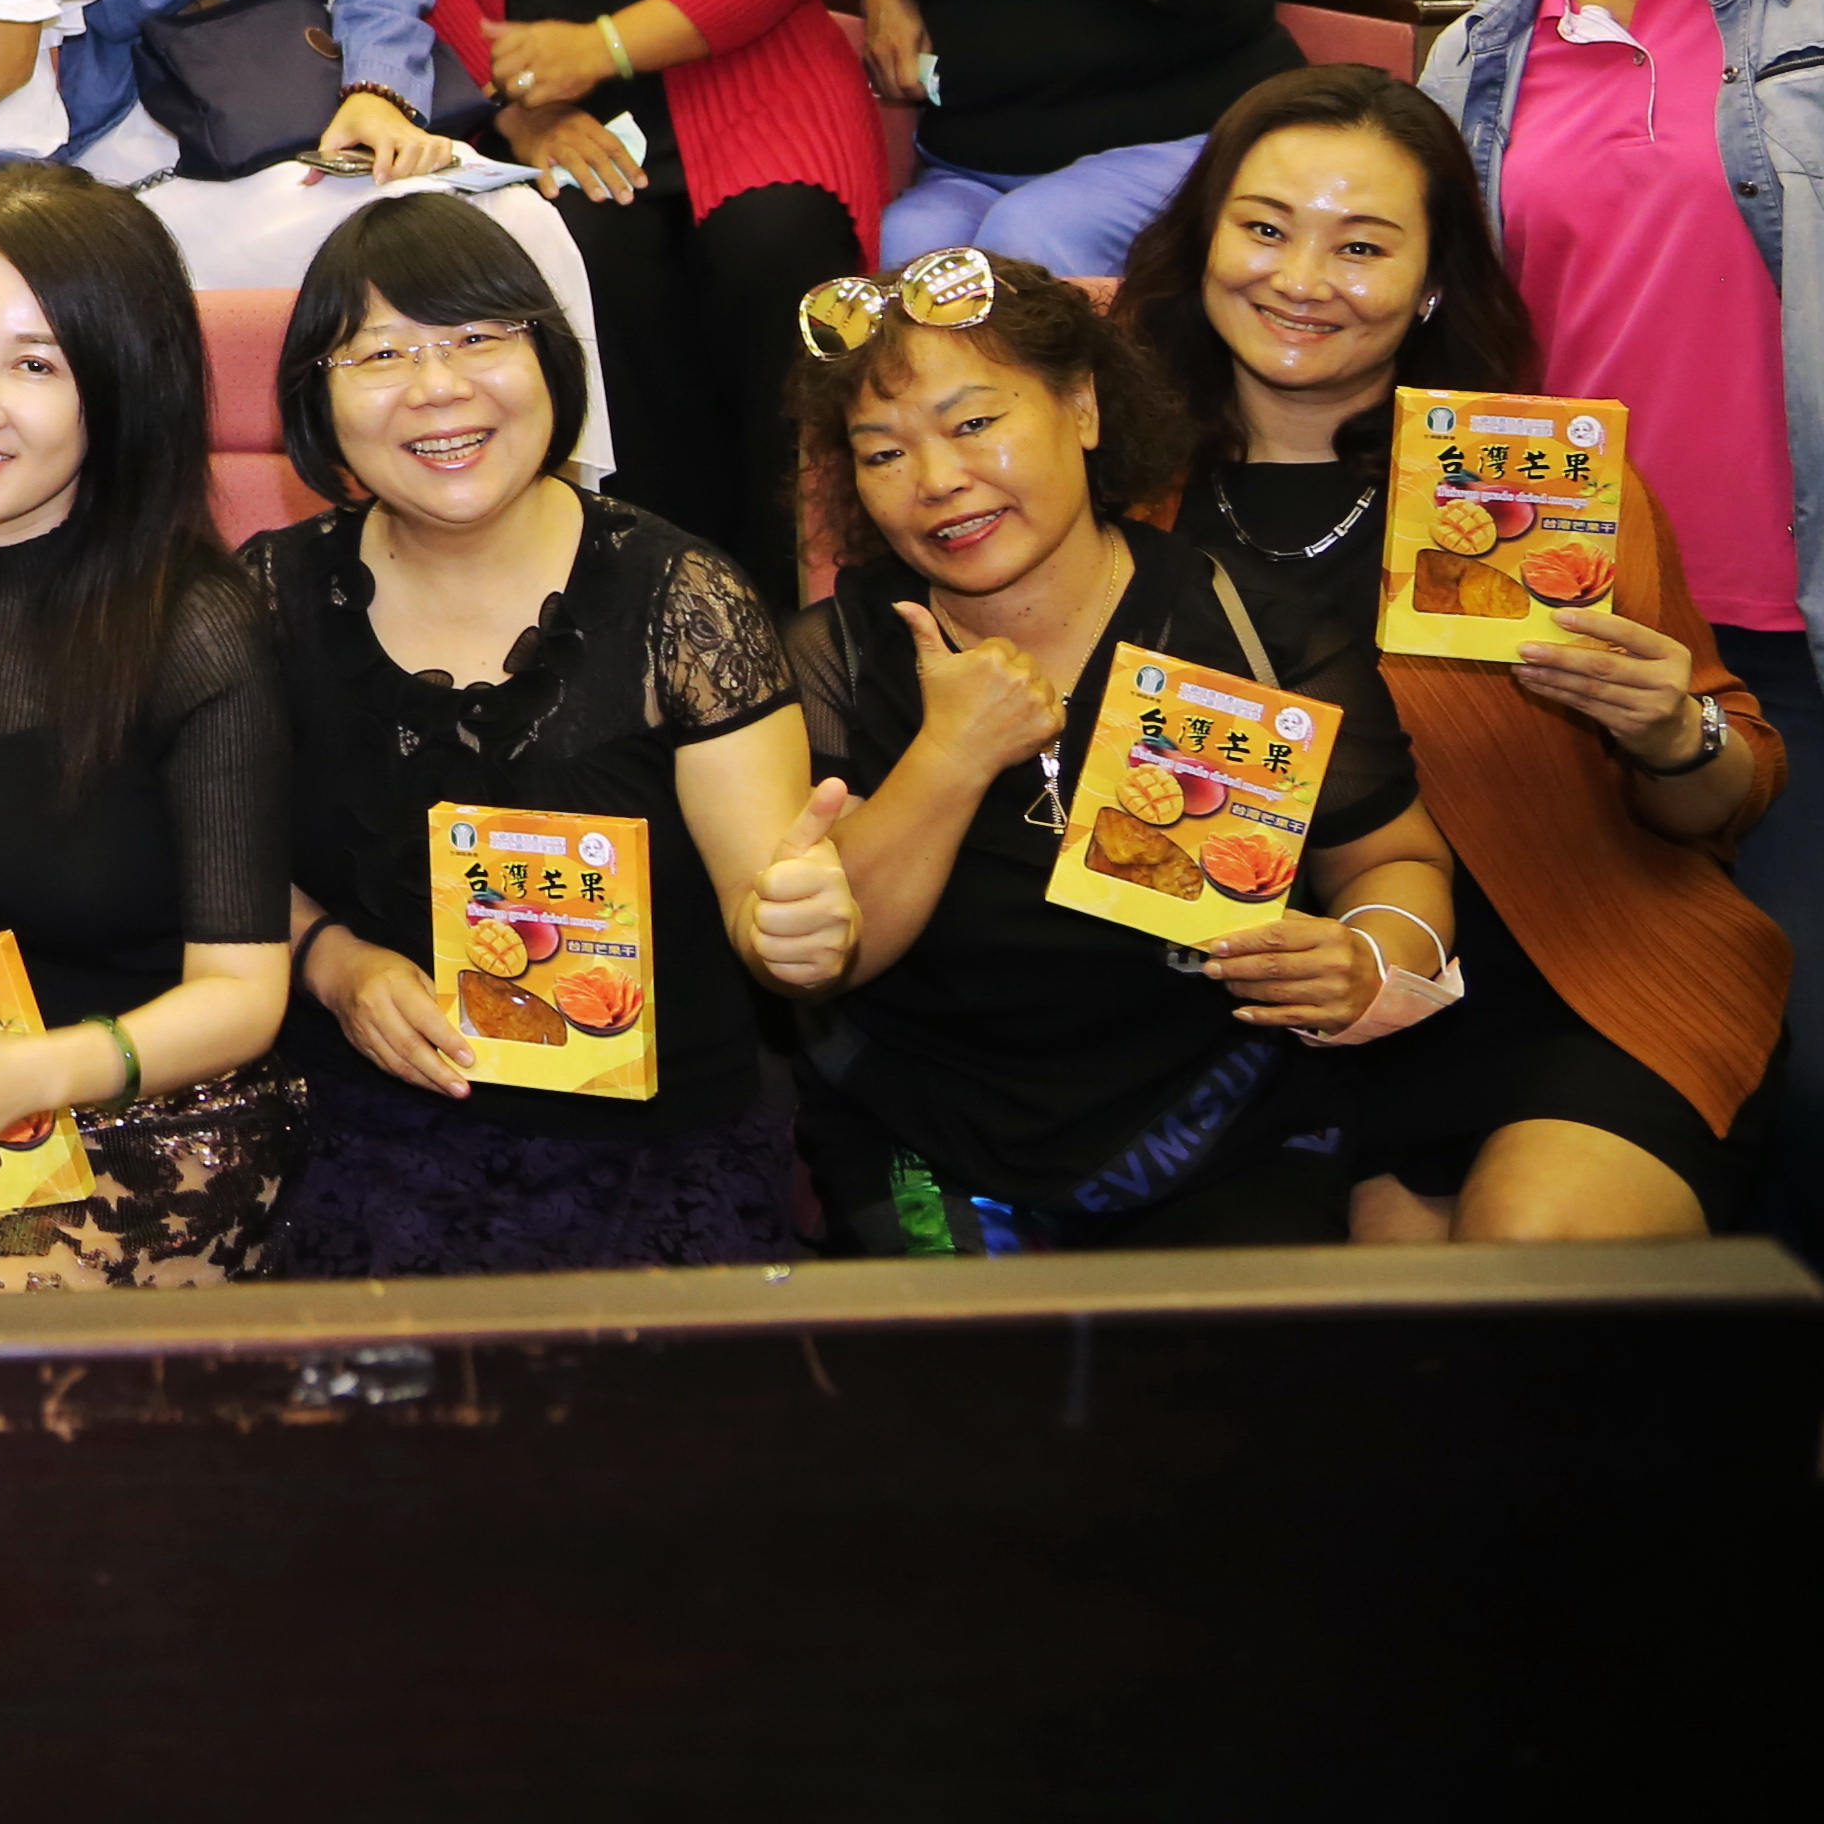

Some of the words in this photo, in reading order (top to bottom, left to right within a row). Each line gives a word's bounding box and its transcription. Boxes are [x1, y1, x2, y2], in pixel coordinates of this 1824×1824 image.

[1437, 444, 1591, 483] 台灣芒果
[1139, 707, 1293, 774] 台灣芒果
[465, 861, 605, 903] 台灣芒果
